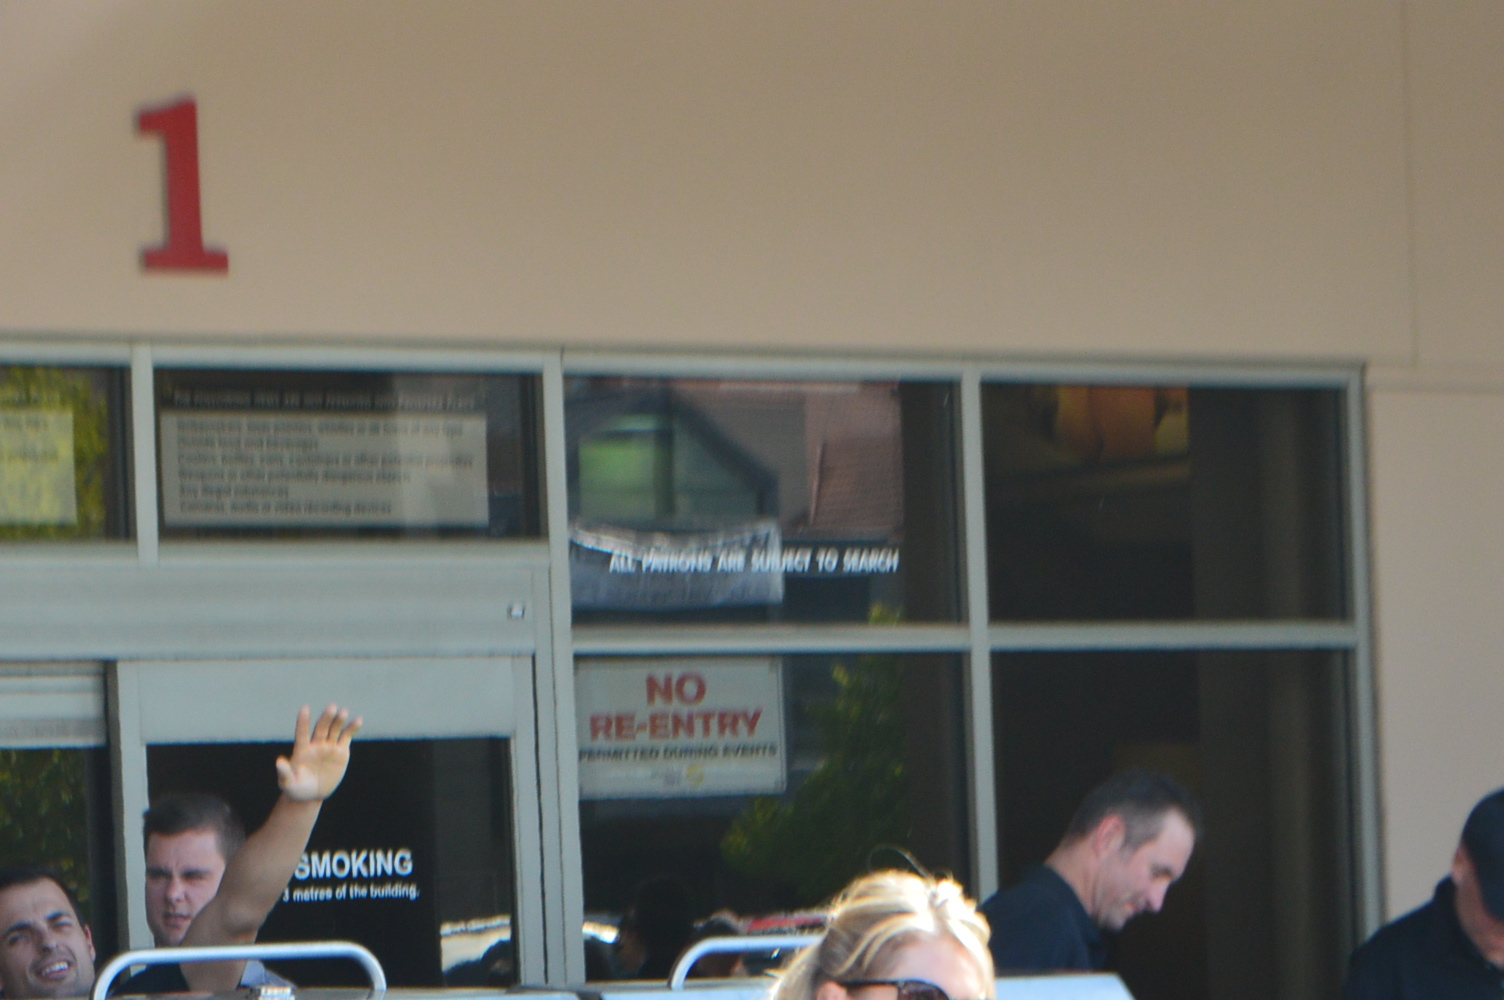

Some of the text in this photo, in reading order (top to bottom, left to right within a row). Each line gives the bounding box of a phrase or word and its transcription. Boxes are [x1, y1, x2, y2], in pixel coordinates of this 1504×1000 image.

[134, 92, 230, 275] 1
[609, 547, 900, 574] ALL PATRONS ARE SUBJECT TO SEARCH
[646, 671, 707, 706] NO
[589, 708, 763, 742] RE-ENTRY
[295, 848, 413, 880] SMOKING
[293, 885, 333, 902] metres
[335, 883, 347, 901] of
[349, 883, 368, 900] the
